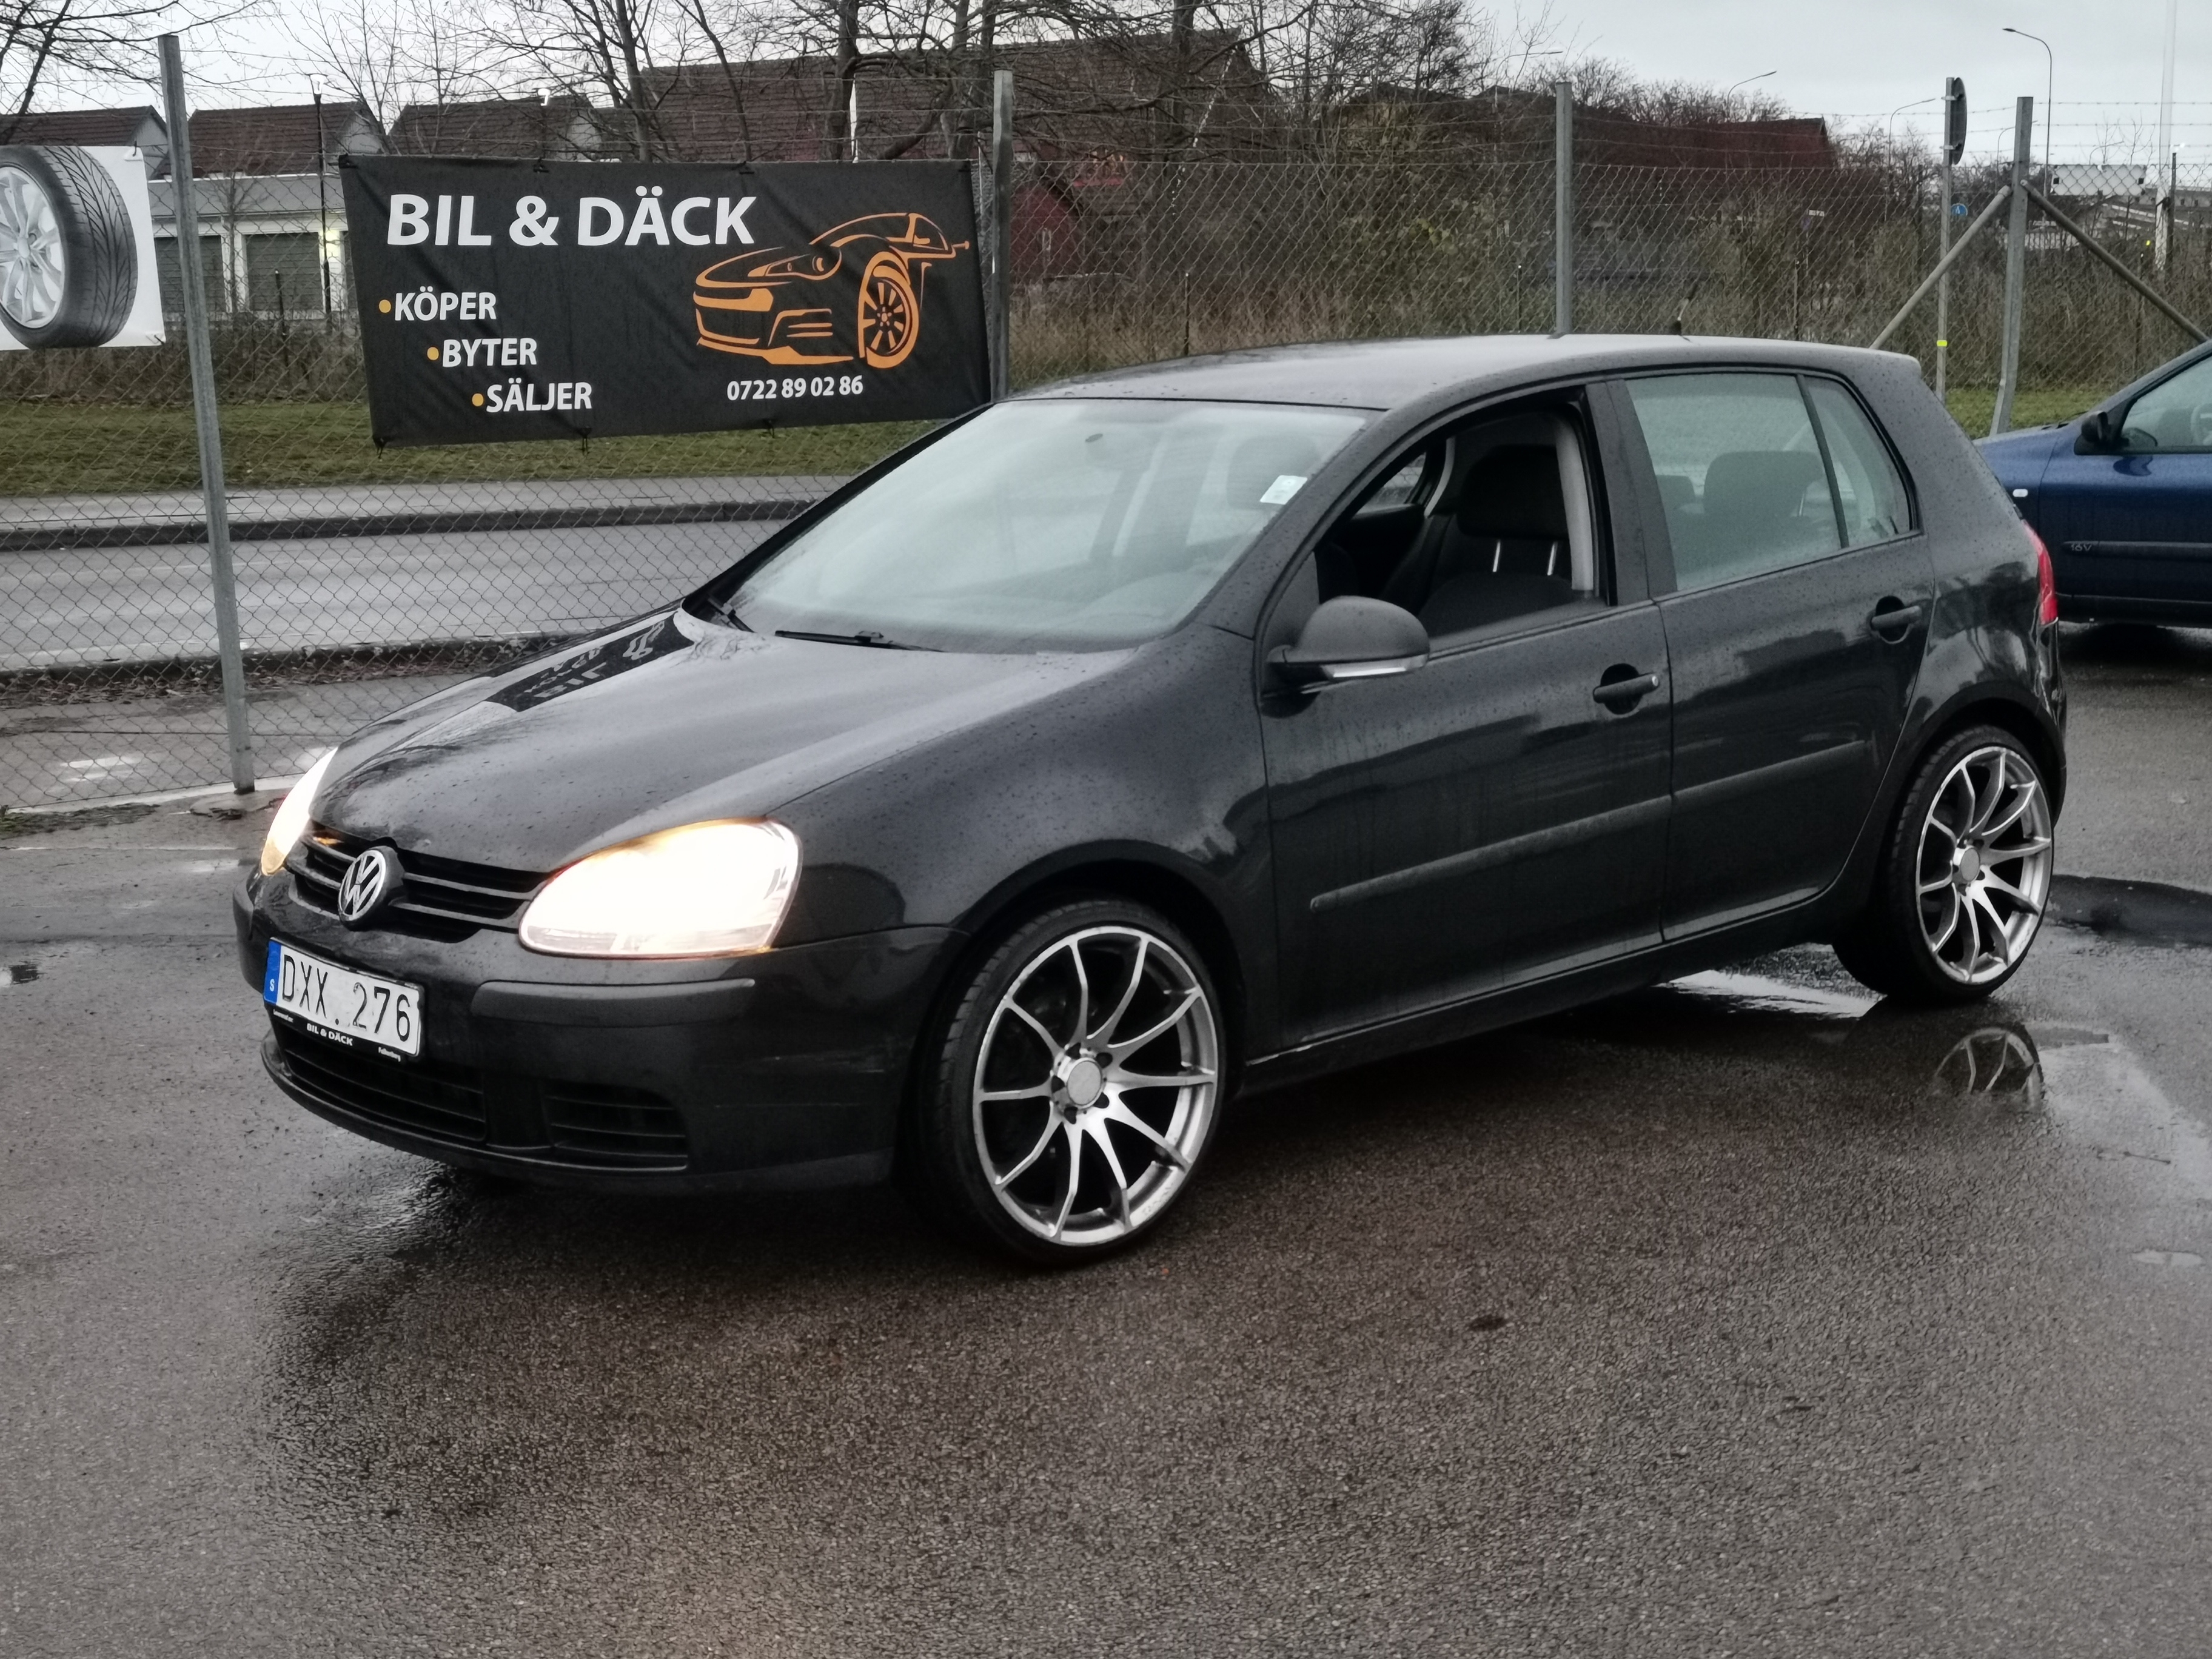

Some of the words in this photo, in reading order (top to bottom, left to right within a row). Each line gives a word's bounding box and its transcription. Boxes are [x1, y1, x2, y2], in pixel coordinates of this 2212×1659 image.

[387, 193, 492, 246] BIL
[509, 195, 560, 247] &
[577, 186, 757, 246] DÄCK
[395, 286, 497, 321] KÖPER
[442, 337, 537, 367] BYTER
[486, 378, 592, 413] SÄLJER
[726, 379, 777, 401] 0722
[781, 378, 806, 398] 89
[810, 376, 835, 397] 02
[839, 375, 863, 395] 86
[269, 979, 275, 992] S
[281, 954, 328, 1019] DXX
[353, 982, 411, 1042] 276
[307, 1023, 319, 1034] BIL
[320, 1028, 328, 1037] &
[328, 1031, 353, 1047] DÄCK
